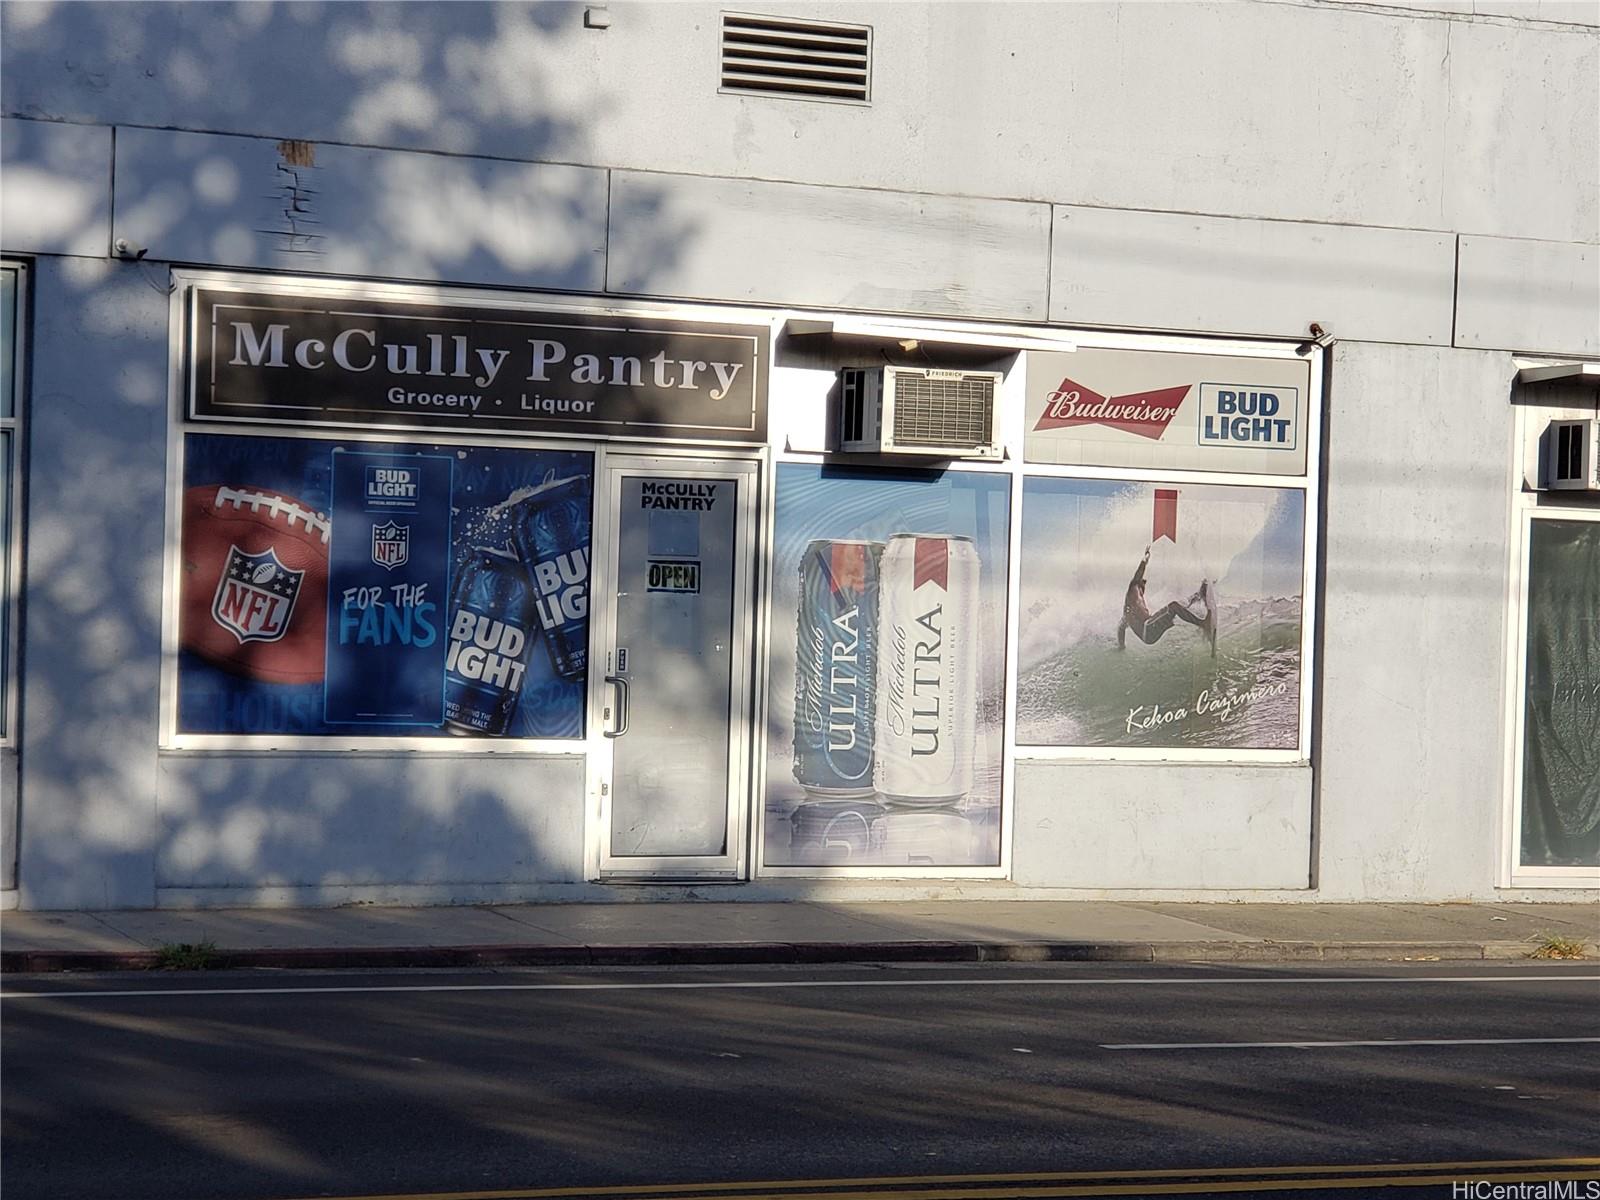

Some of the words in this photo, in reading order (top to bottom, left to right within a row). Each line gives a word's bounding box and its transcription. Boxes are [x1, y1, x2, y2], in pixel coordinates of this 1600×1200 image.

[228, 321, 510, 388] McCully
[526, 338, 743, 401] Pantry
[387, 387, 481, 411] Grocery
[520, 393, 595, 415] Liquor
[1046, 390, 1176, 423] Budweiser
[1217, 390, 1280, 417] BUD
[1204, 416, 1291, 443] LIGHT
[368, 482, 417, 497] LIGHT
[375, 469, 411, 483] BUD
[641, 482, 717, 497] McCULLY
[641, 496, 716, 511] PANTRY
[376, 541, 404, 562] NFL
[534, 546, 589, 596] BU
[648, 564, 696, 589] OPEN
[220, 581, 281, 633] NFL
[343, 586, 386, 611] FOR
[390, 583, 428, 609] THE
[339, 601, 437, 649] FANS
[450, 609, 525, 658] BUD
[949, 625, 957, 649] BEER
[804, 626, 825, 733] Michelob
[828, 605, 860, 753] ULTRA
[886, 624, 907, 737] Michelob
[911, 606, 943, 758] ULTRA
[948, 655, 956, 684] LIGHT
[947, 688, 955, 736] SUPERIOR
[1125, 704, 1188, 734] Kekoa
[1195, 680, 1287, 722] Cazimero
